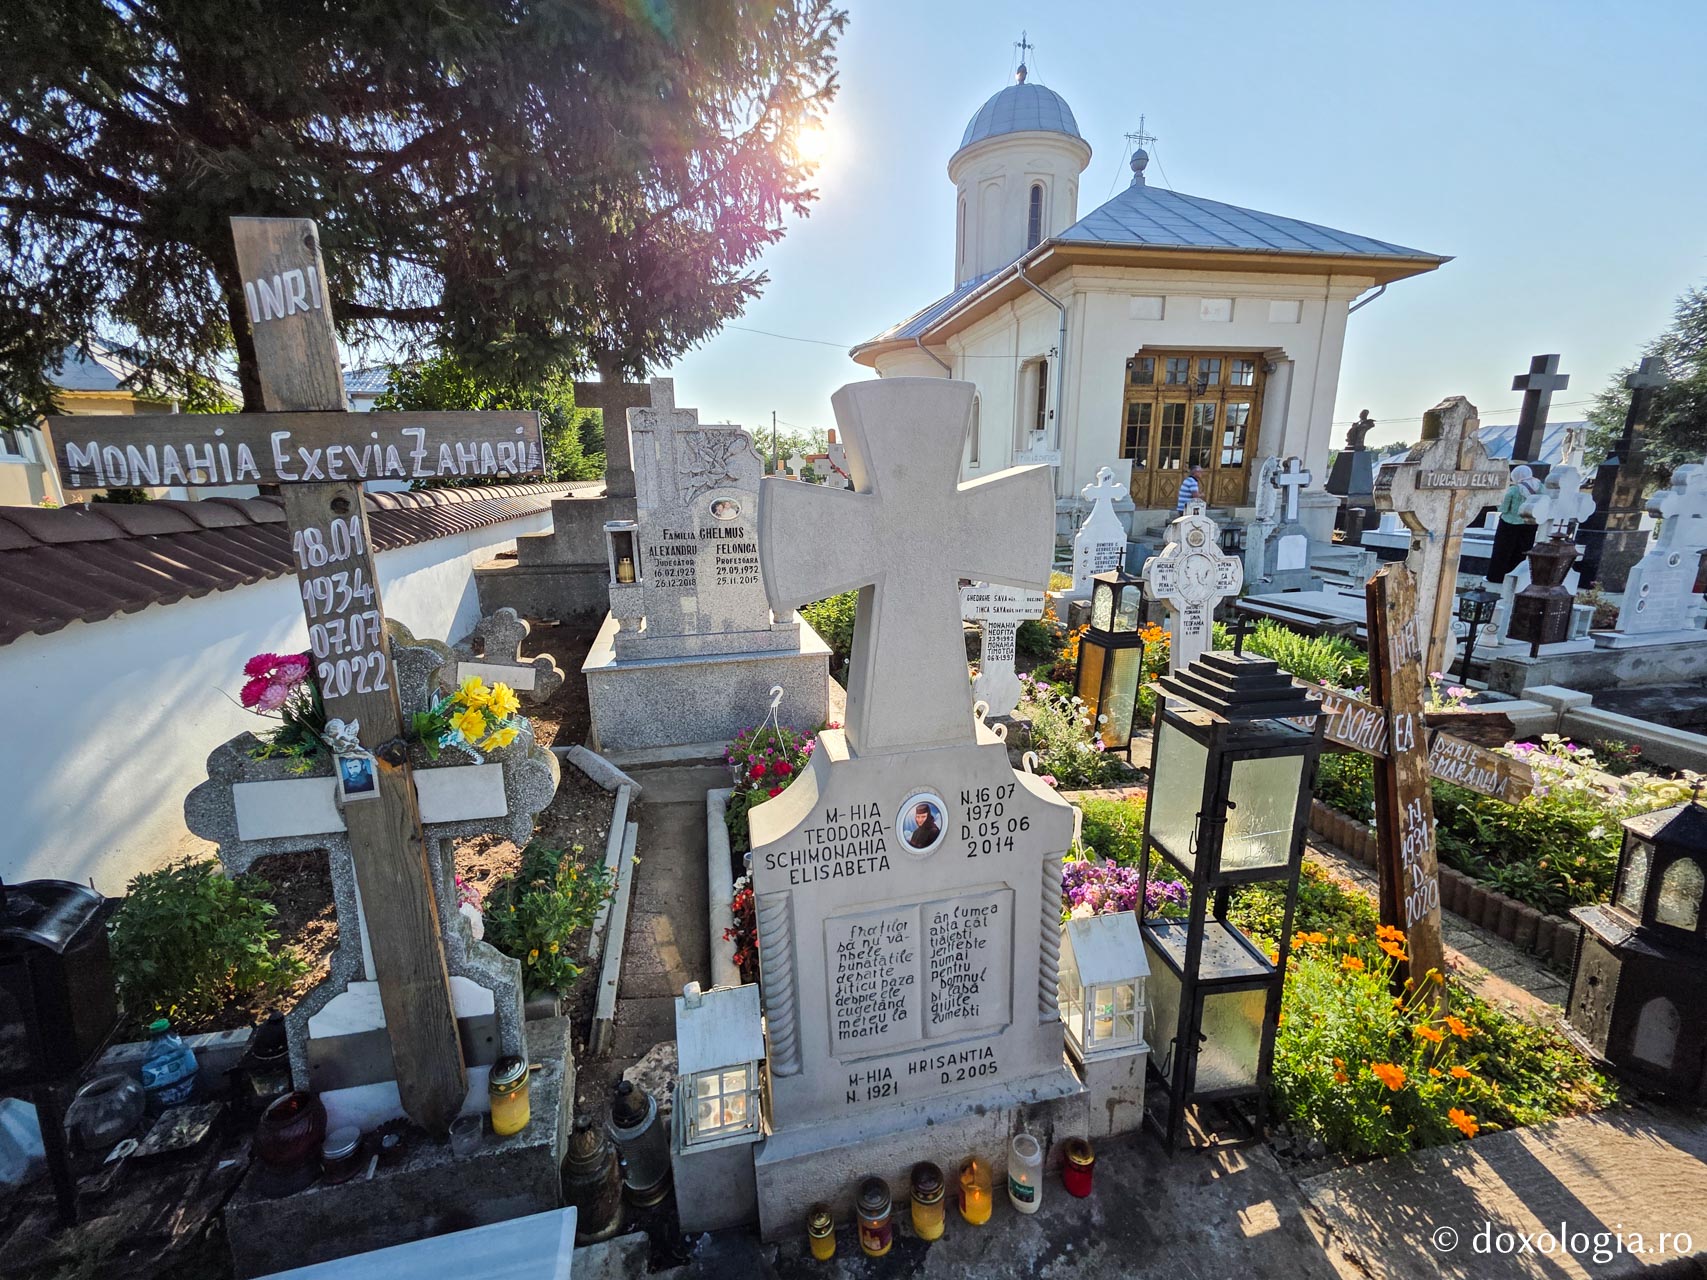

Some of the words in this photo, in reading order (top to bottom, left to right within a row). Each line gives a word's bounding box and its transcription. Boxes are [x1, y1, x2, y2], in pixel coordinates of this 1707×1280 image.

[246, 266, 321, 323] INRI
[293, 515, 364, 570] 18.01
[649, 545, 698, 557] ALEXANDRU
[303, 568, 374, 618] 1934
[310, 610, 381, 659] 07.07
[318, 651, 389, 700] 2022
[996, 783, 1015, 800] 07
[966, 802, 1004, 822] 1970
[1007, 816, 1031, 833] 06
[765, 838, 887, 870] SCHIMONAHIA
[967, 835, 1014, 858] 2014
[790, 855, 890, 885] ELISABETA
[1405, 879, 1438, 929] 2020
[908, 1046, 994, 1075] HRISANTIA
[867, 1081, 898, 1100] 1921
